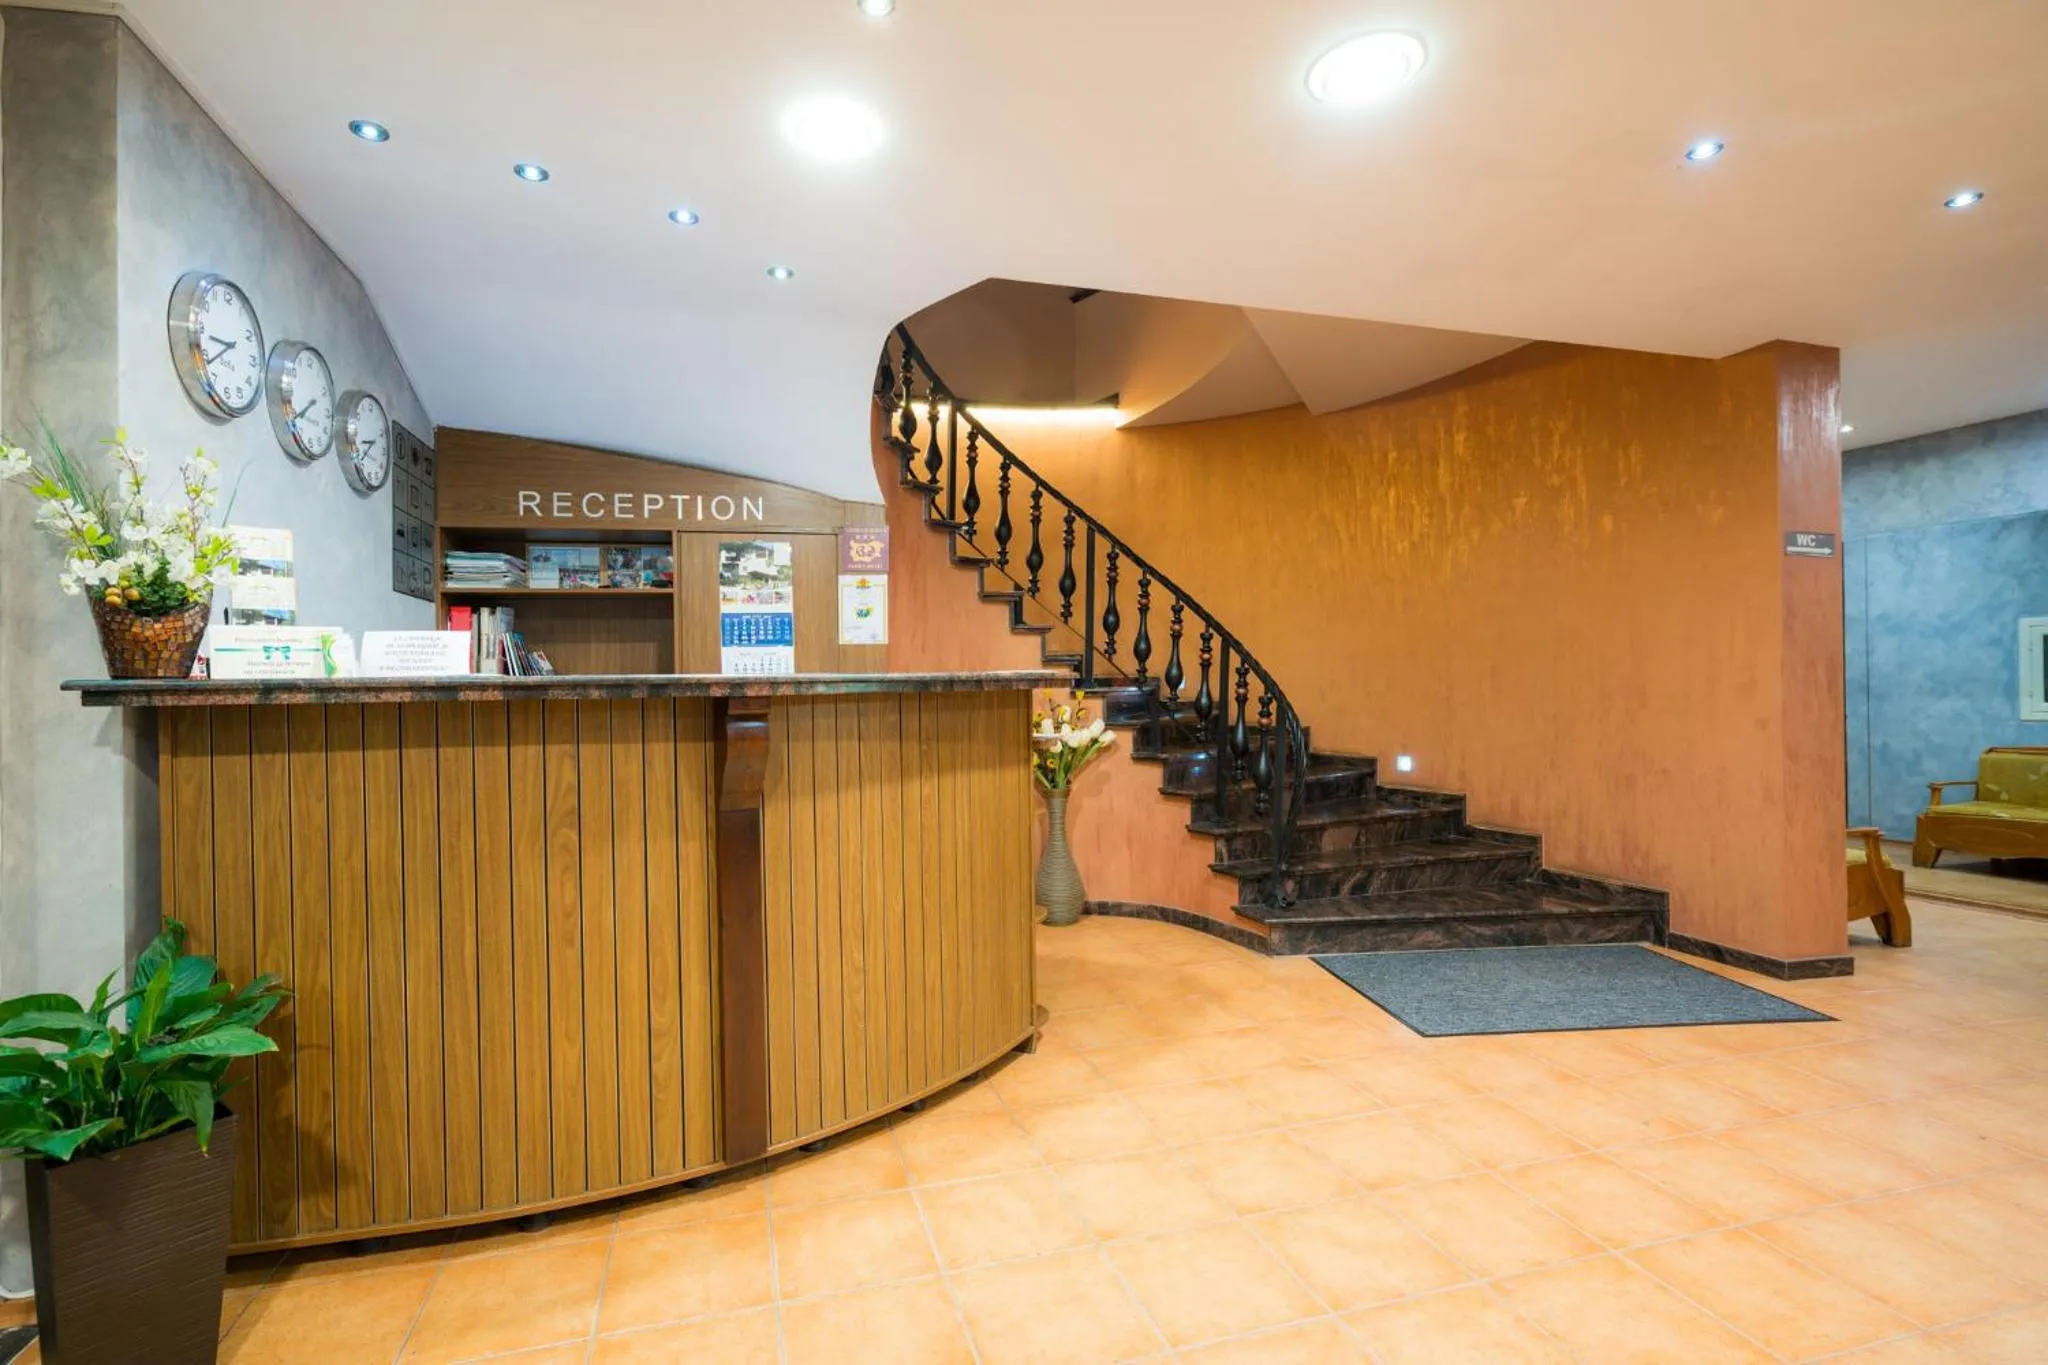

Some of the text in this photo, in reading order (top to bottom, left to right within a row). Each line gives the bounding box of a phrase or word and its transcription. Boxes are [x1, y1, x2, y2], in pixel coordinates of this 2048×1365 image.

[223, 290, 233, 306] 12
[244, 329, 254, 343] 2
[248, 354, 257, 368] 3
[223, 386, 231, 400] 6
[236, 387, 244, 400] 5
[518, 491, 763, 521] RECEPTION
[1796, 534, 1816, 547] WC
